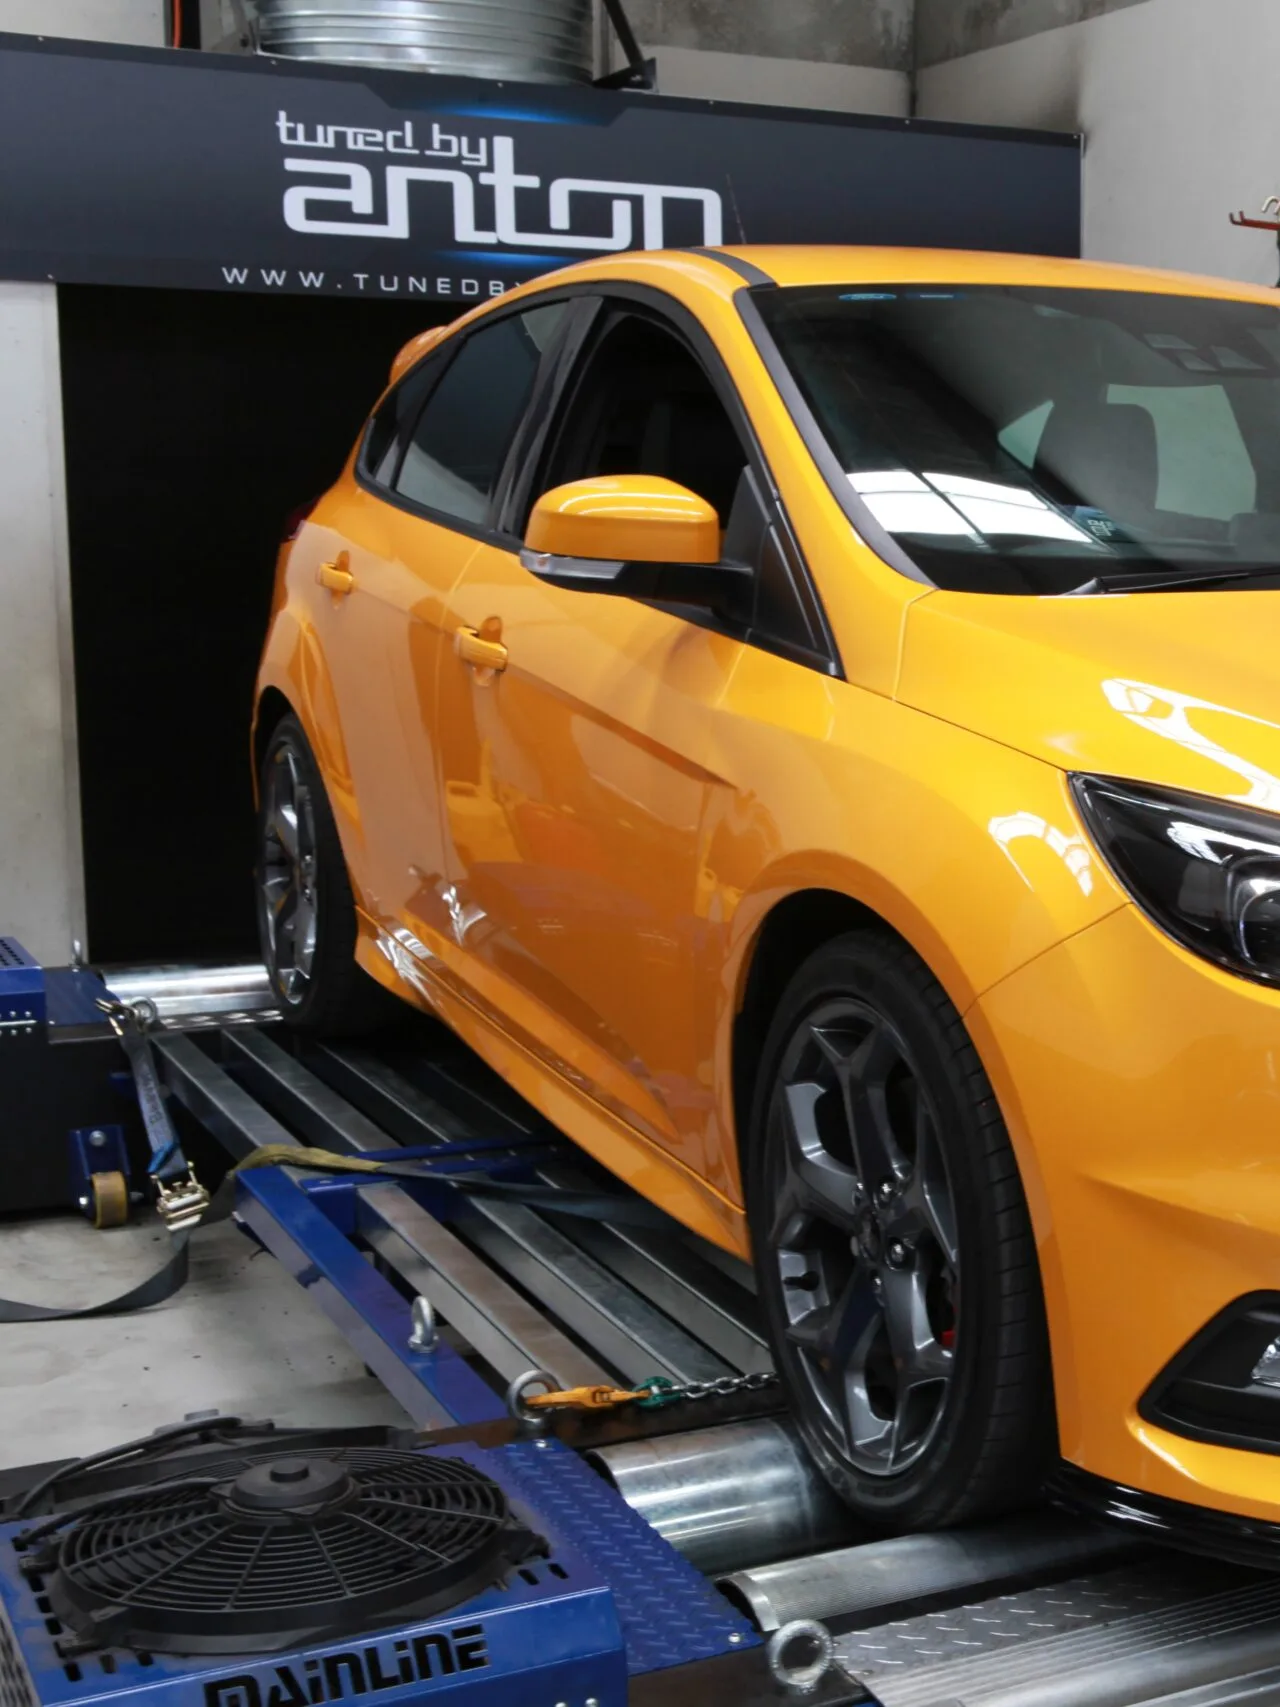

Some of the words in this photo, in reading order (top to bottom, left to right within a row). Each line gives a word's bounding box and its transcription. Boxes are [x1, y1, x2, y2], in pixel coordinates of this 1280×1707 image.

[276, 110, 420, 154] tuned
[425, 122, 488, 167] by
[282, 136, 723, 250] anton
[221, 266, 522, 296] WWW.TUNEDB
